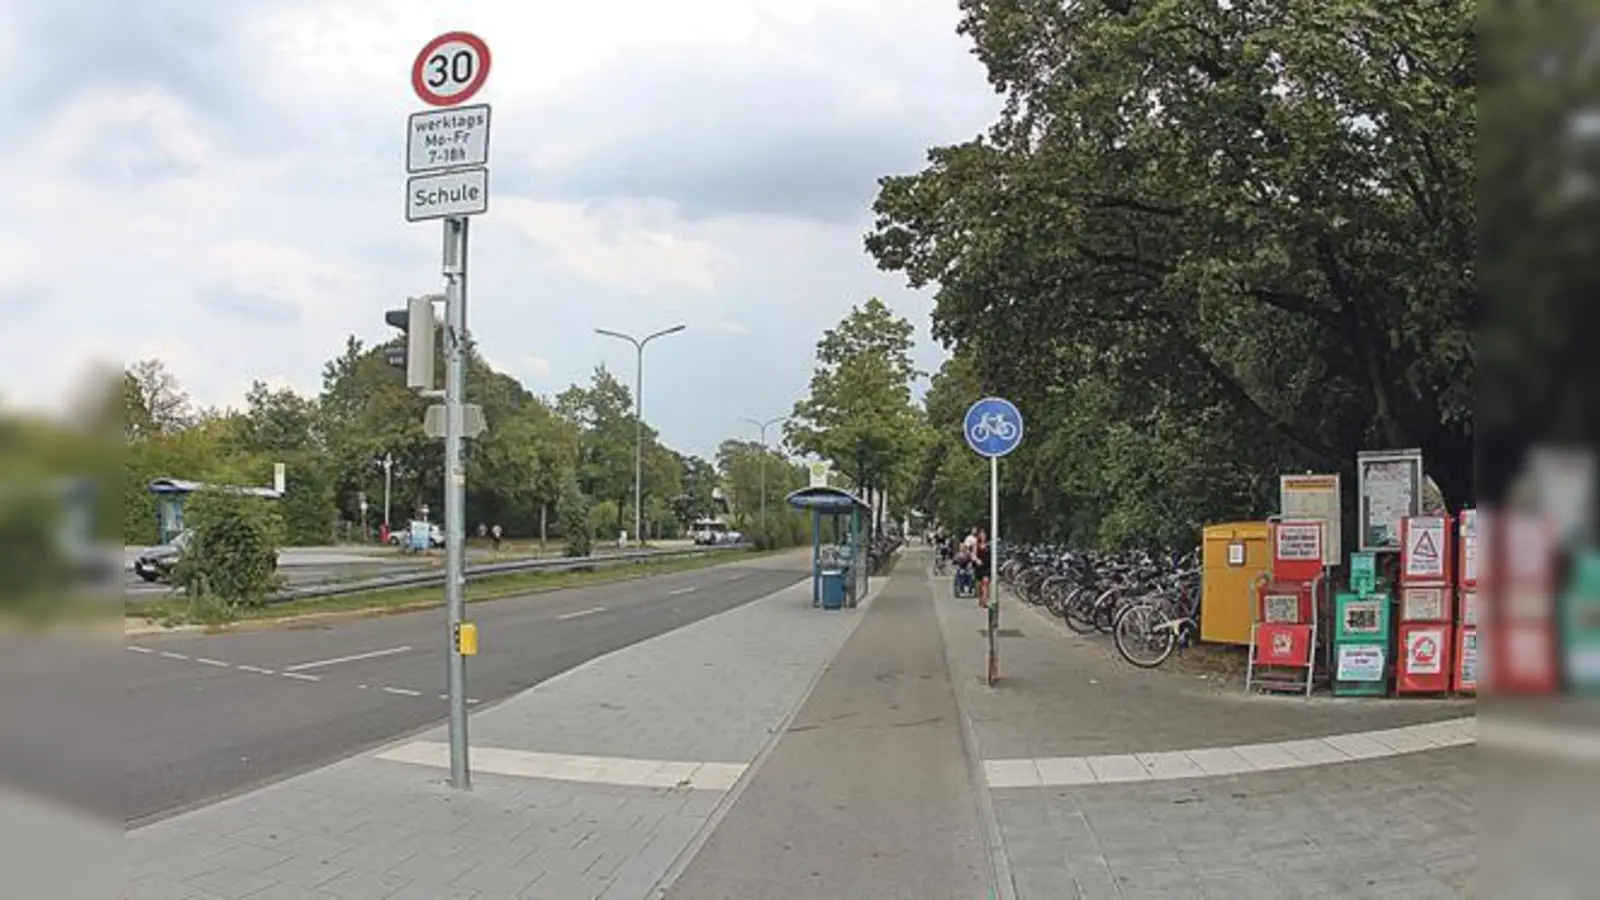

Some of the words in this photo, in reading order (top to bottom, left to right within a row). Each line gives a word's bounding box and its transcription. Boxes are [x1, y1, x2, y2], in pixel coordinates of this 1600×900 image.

[428, 50, 473, 88] 30
[414, 113, 484, 133] werktags
[425, 130, 471, 147] Mo-Fr
[414, 183, 480, 206] Schule
